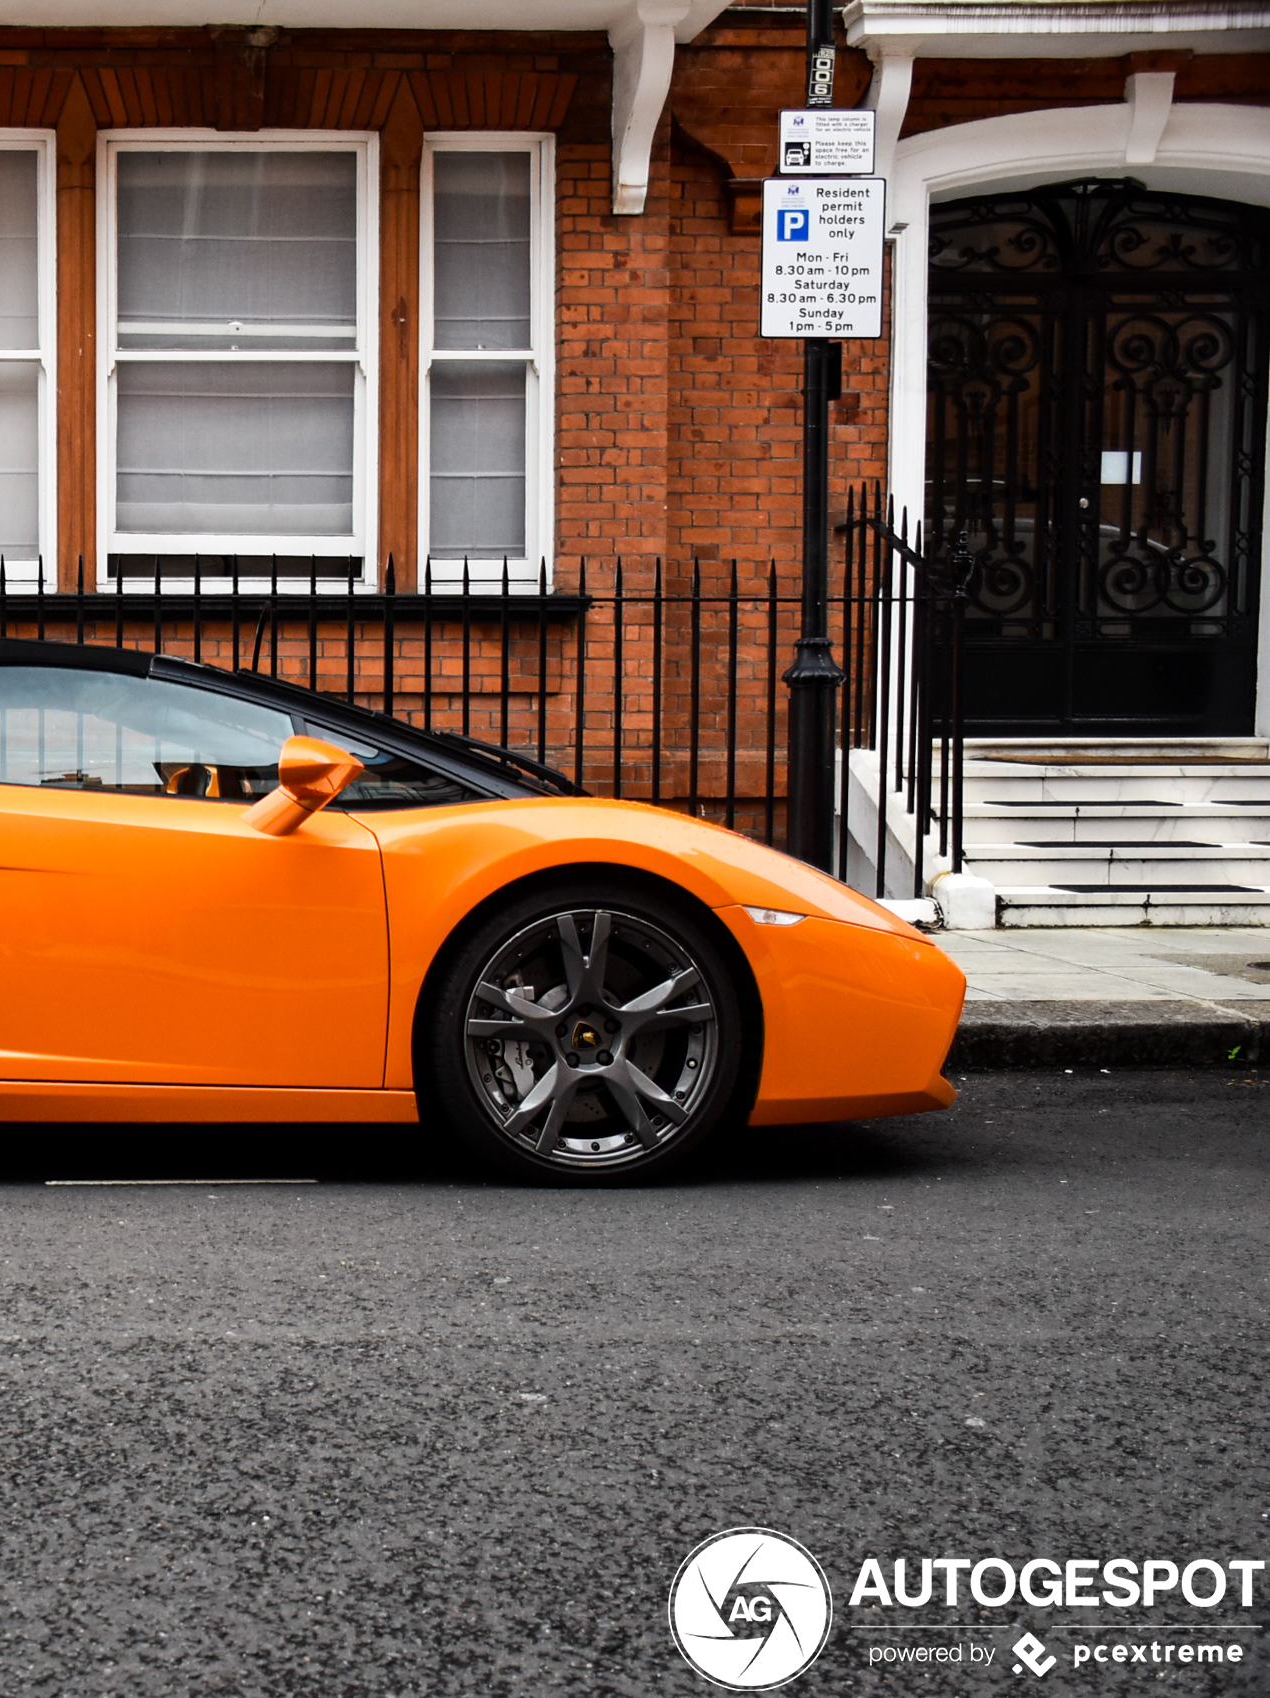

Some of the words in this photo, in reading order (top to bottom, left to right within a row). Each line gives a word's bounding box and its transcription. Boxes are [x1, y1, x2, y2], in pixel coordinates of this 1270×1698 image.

[816, 188, 870, 198] Resident
[822, 202, 863, 212] permit
[819, 215, 865, 225] holders
[784, 212, 805, 240] P
[828, 228, 855, 240] only
[796, 253, 822, 262] Mon
[833, 253, 849, 262] Fri
[794, 280, 850, 291] Saturday
[799, 308, 844, 320] Sunday
